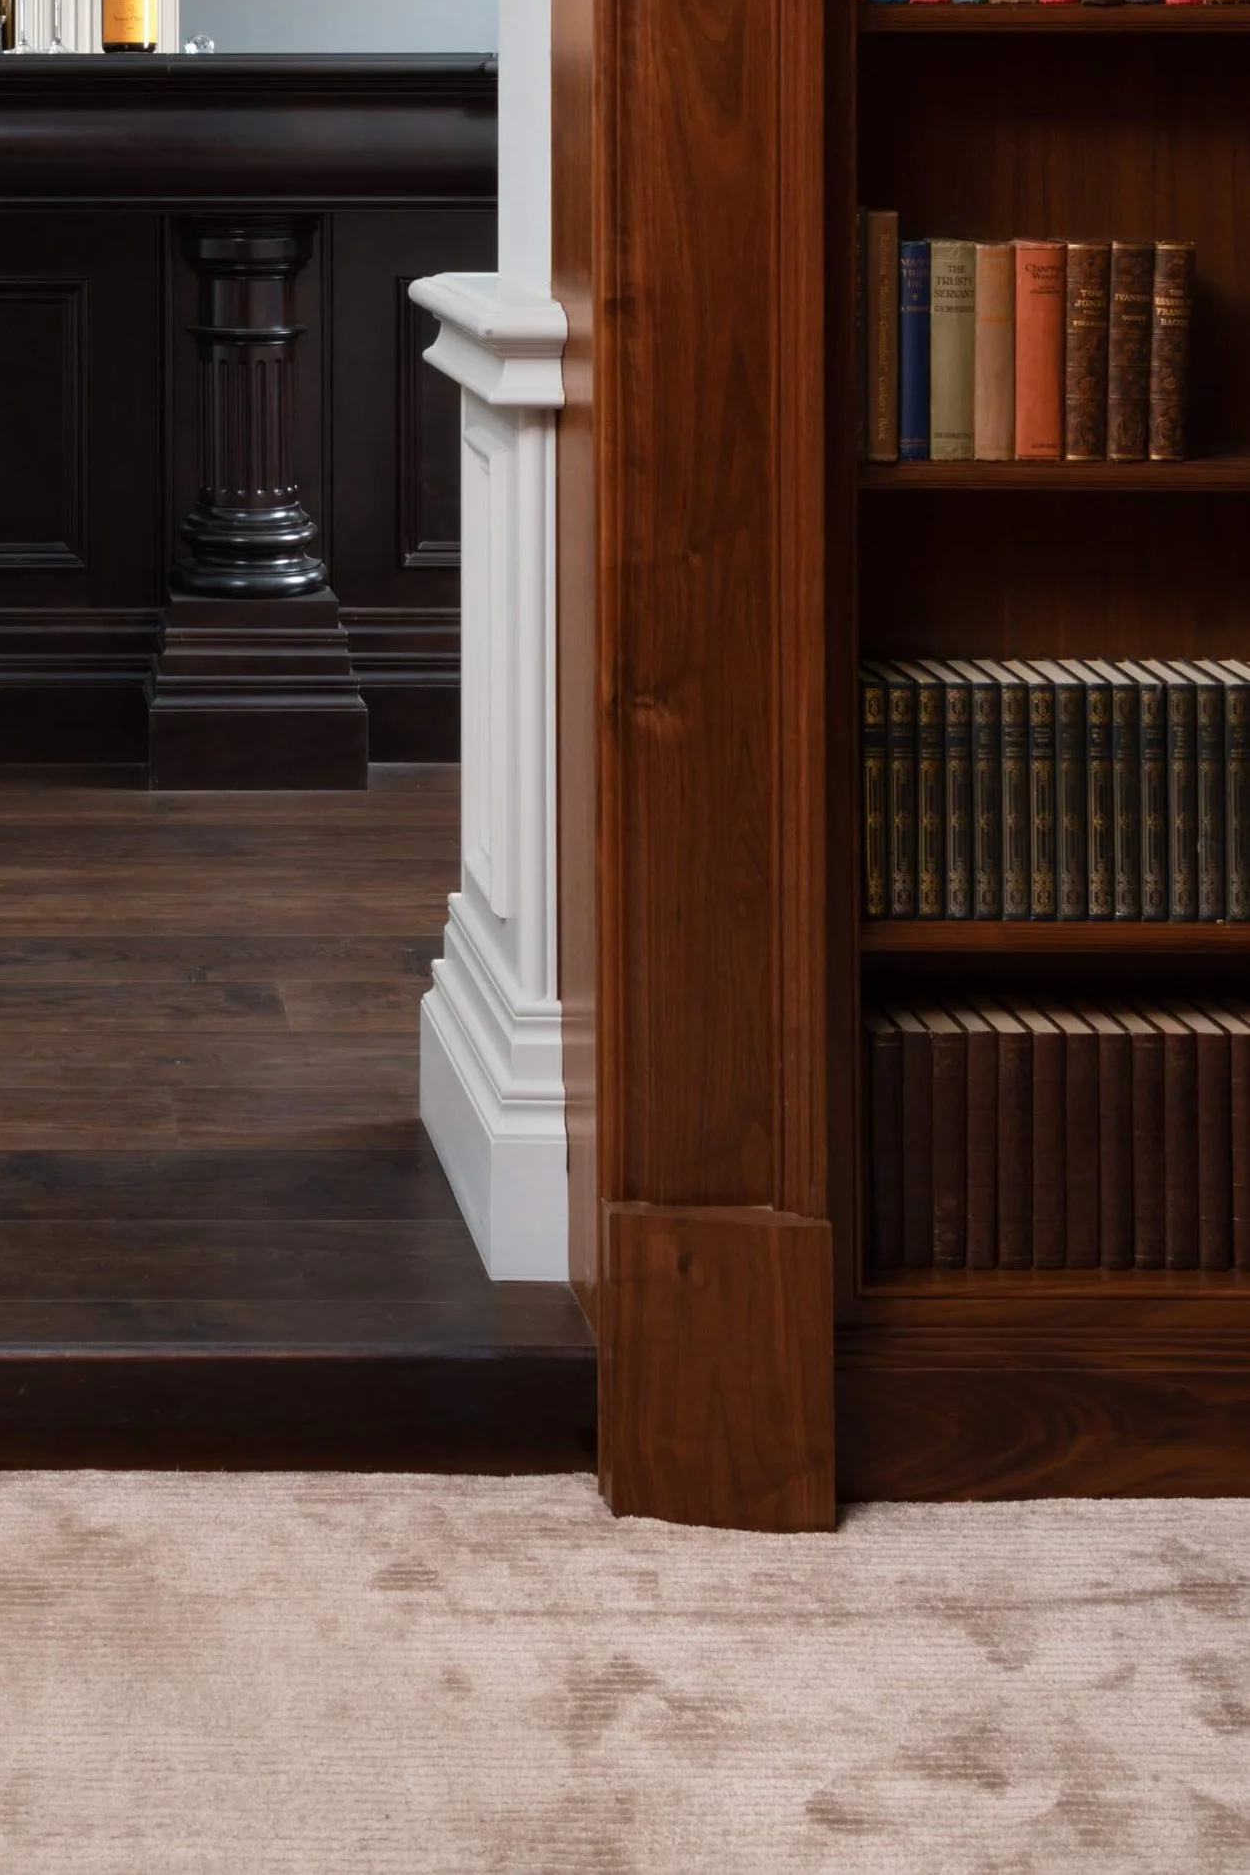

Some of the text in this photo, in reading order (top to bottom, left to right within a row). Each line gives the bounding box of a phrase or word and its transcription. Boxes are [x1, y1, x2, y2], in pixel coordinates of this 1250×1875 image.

[948, 265, 966, 273] THE
[934, 289, 974, 299] SERVANT
[1080, 289, 1102, 297] TOM
